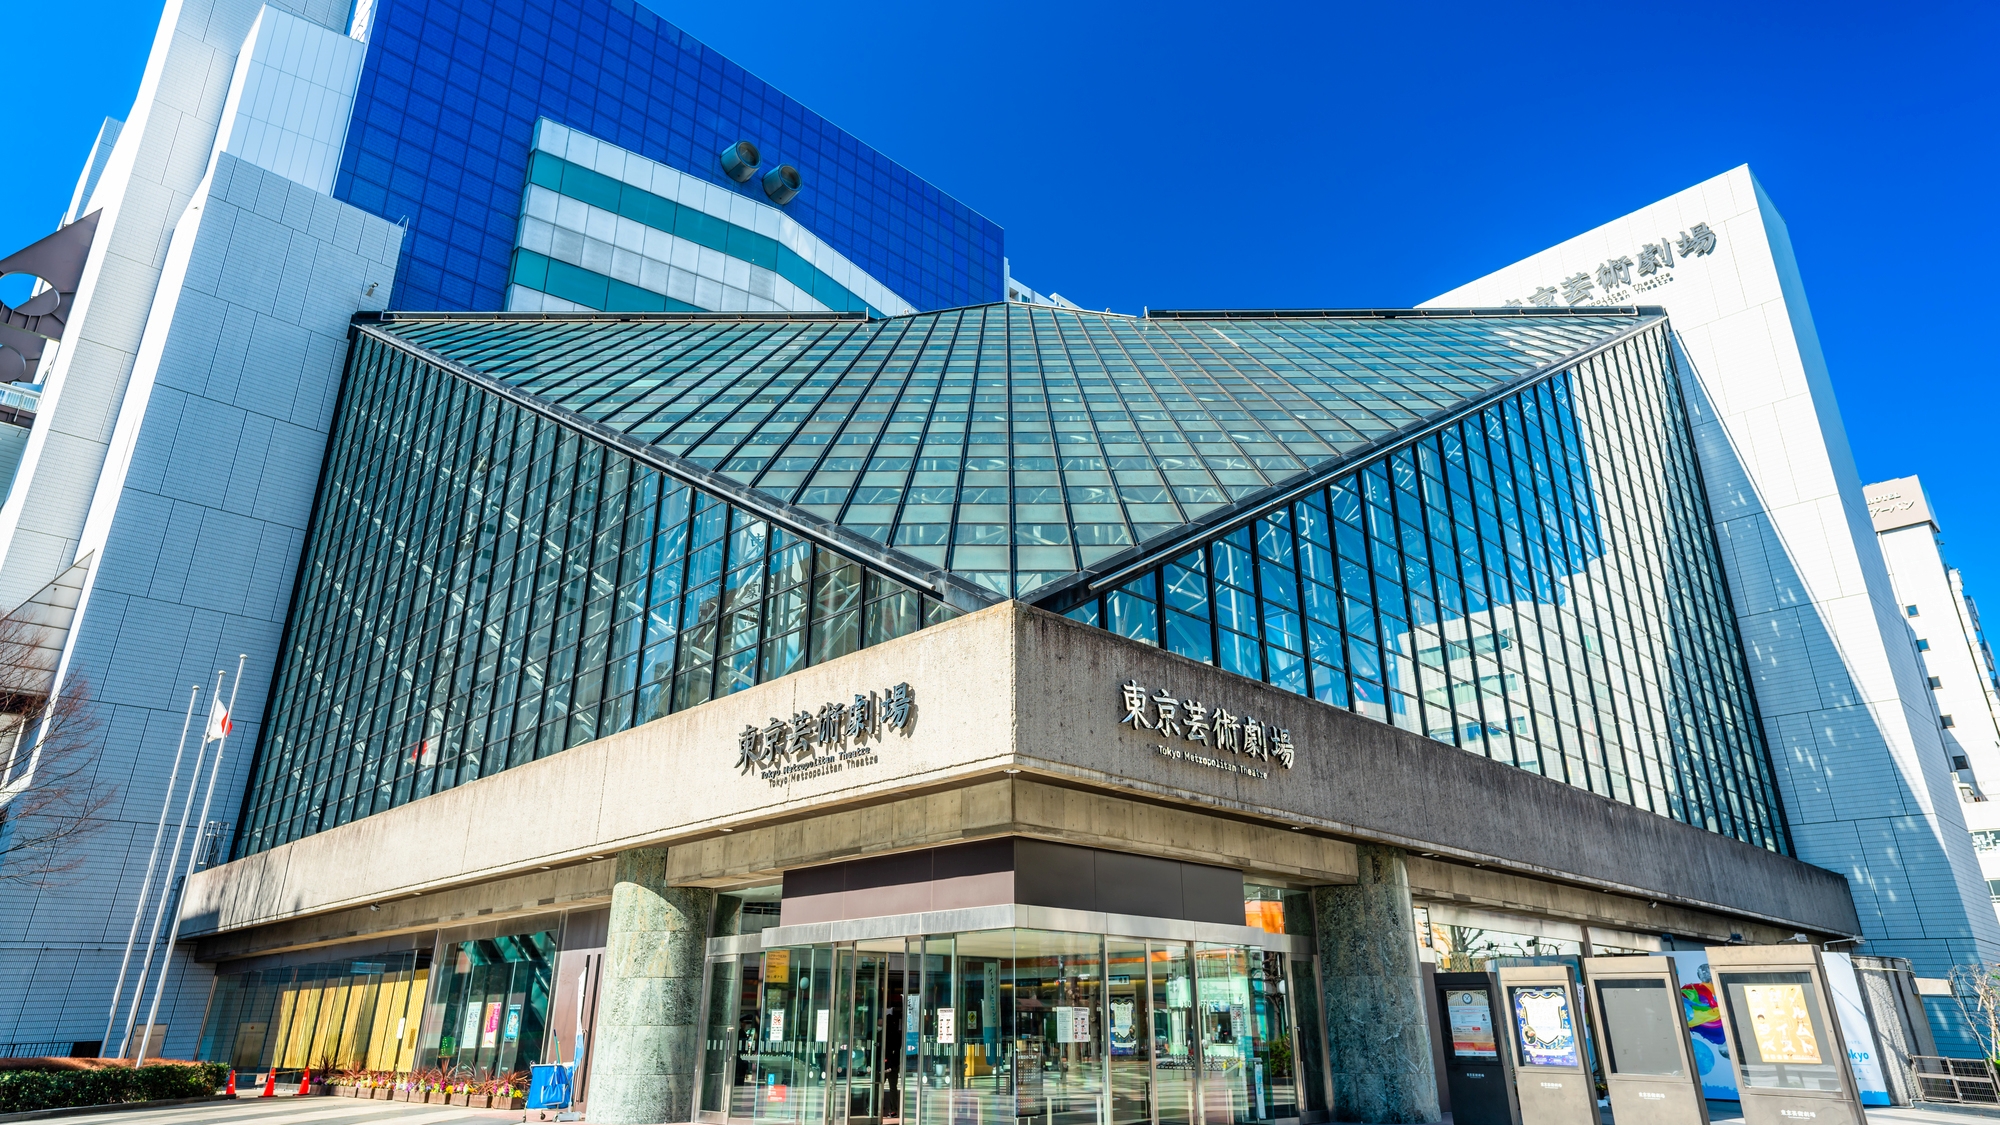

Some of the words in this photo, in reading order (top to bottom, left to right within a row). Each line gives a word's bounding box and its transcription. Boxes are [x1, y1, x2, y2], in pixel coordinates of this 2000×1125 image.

[1503, 221, 1717, 308] 京芸術劇場
[1632, 272, 1671, 292] Theatre
[734, 681, 918, 769] 東京芸術劇場
[1119, 679, 1296, 770] 東京芸術劇場
[783, 755, 835, 775] Metropolitan
[838, 747, 871, 762] Theatre
[1157, 744, 1181, 760] Tokyo
[1183, 751, 1237, 773] Metropolitan
[1239, 764, 1268, 780] Theatre
